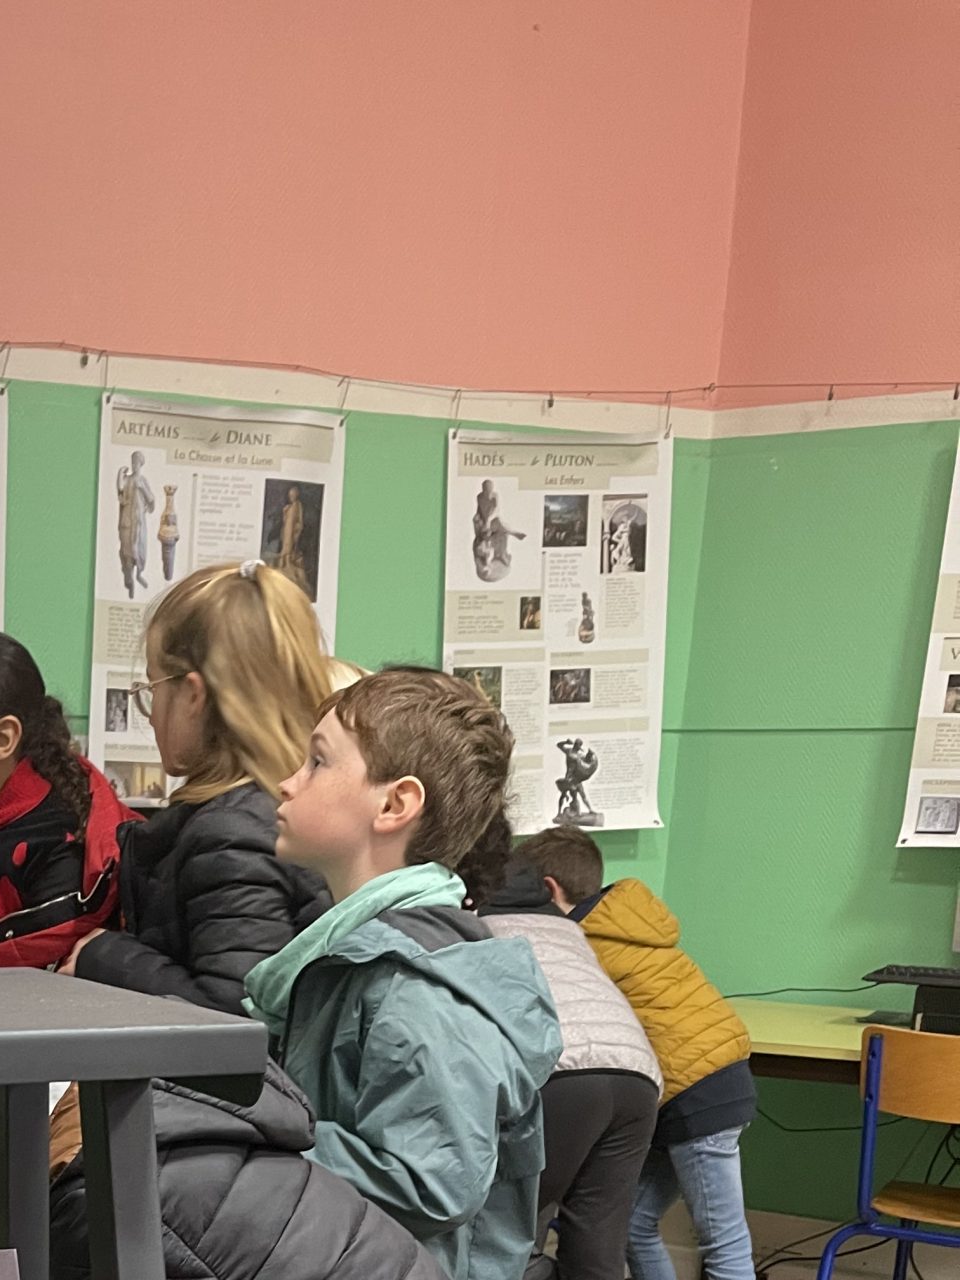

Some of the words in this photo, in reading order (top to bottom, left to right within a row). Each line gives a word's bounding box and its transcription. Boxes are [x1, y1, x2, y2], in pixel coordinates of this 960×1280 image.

[117, 420, 180, 440] ARTÉMIS
[225, 430, 272, 447] DIANE
[174, 449, 186, 460] La
[188, 450, 222, 464] Chasse
[225, 453, 235, 464] et
[237, 454, 248, 465] la
[250, 455, 273, 466] Lune
[544, 453, 595, 467] PLUTON
